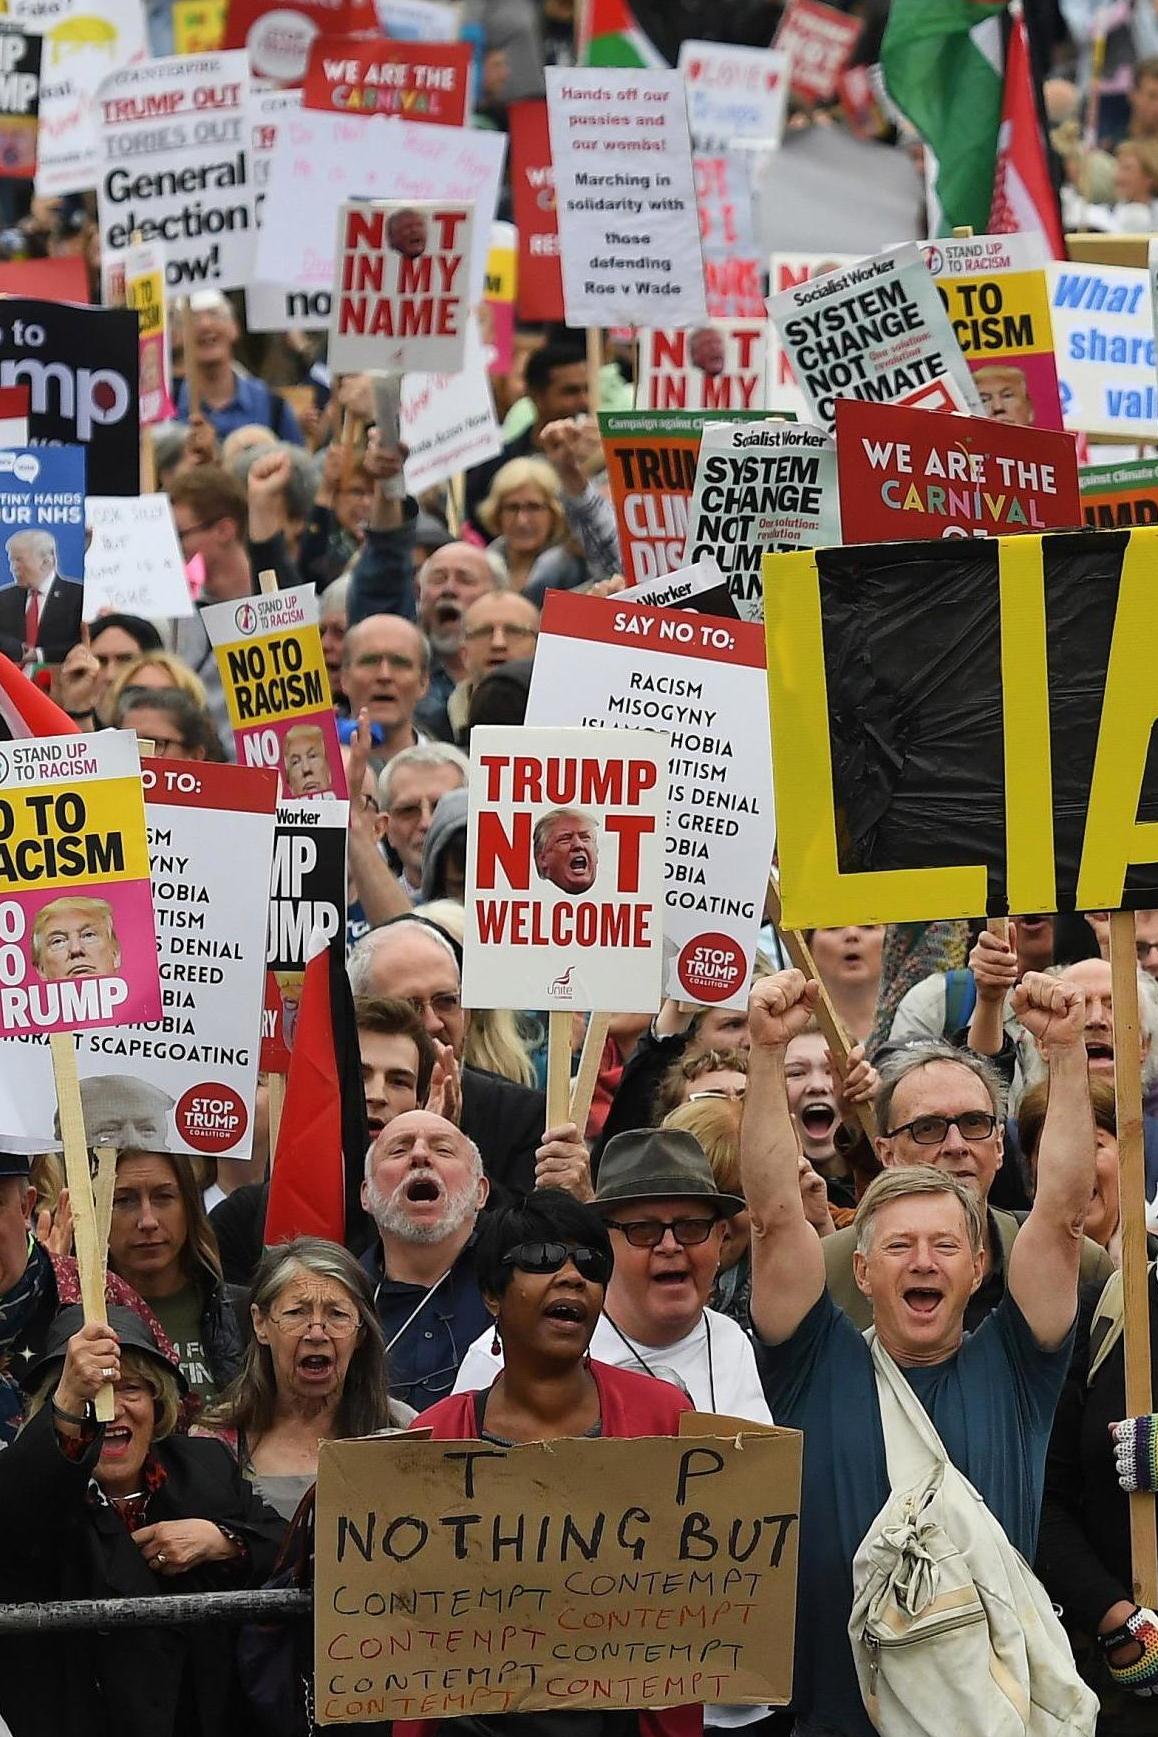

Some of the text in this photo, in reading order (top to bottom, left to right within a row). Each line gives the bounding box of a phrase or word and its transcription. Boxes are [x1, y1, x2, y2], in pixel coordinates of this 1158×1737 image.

[323, 59, 456, 91] WE ARE THE
[103, 90, 184, 121] TRUMP
[193, 83, 241, 107] OUT
[332, 85, 440, 115] CARNIVAL
[561, 87, 669, 102] Hands off our
[569, 114, 664, 127] pussies and
[572, 139, 597, 151] our
[106, 152, 247, 203] General
[575, 172, 650, 188] Marching
[656, 172, 670, 186] in
[567, 198, 684, 213] solidarity with
[107, 203, 249, 248] election
[604, 231, 651, 244] those
[589, 257, 671, 272] defending
[946, 246, 982, 259] STAND
[965, 256, 1011, 271] RACISM
[343, 256, 462, 293] IN MY
[584, 281, 682, 295] Roe Wade
[957, 282, 1003, 317] TO
[1053, 273, 1144, 314] What
[338, 299, 460, 336] NAME
[785, 280, 908, 347] SYSTEM
[14, 318, 45, 347] to
[796, 303, 925, 371] CHANGE
[804, 354, 867, 398] NOT
[651, 376, 758, 408] IN MY
[781, 431, 827, 448] Worker
[704, 456, 819, 485] SYSTEM
[862, 438, 913, 474] WE
[924, 448, 986, 483] ARE
[996, 458, 1058, 494] THE
[0, 492, 81, 505] TINY HANDS
[701, 486, 822, 514] CHANGE
[881, 479, 1045, 528] CARNIVAL
[38, 508, 82, 524] NHS
[696, 515, 755, 544] NOT
[257, 599, 283, 615] STAND
[270, 610, 304, 627] RACISM
[613, 612, 735, 650] SAY NO TO:
[228, 638, 303, 684] NO TO
[237, 671, 324, 720] RACISM
[630, 672, 703, 699] RACISM
[608, 695, 717, 727] MISOGYNY
[13, 743, 88, 764] STAND UP
[15, 760, 98, 781] TO RACISM
[480, 755, 657, 805] TRUMP
[25, 792, 86, 836] TO
[691, 788, 760, 815] DENIAL
[276, 808, 321, 826] Worker
[677, 812, 739, 837] GREED
[0, 832, 125, 882] ACISM
[476, 900, 653, 948] WELCOME
[171, 938, 243, 961] DENIAL
[694, 947, 735, 964] STOP
[159, 963, 224, 985] GREED
[686, 960, 738, 980] TRUMP
[689, 977, 729, 989] COALITION
[3, 976, 129, 1029] RUMP
[89, 1037, 250, 1067] SCAPEGOATING
[184, 1111, 239, 1128] TRUMP
[191, 1099, 234, 1115] STOP
[189, 1129, 231, 1139] COALITION
[337, 1506, 798, 1567] NOTHING BUT
[334, 1567, 762, 1617] CONTEMPT CONTEMPT
[328, 1603, 758, 1662] CONTEMPT CONTEMPT
[329, 1638, 743, 1695] CONTEMPT CONTEMPT
[325, 1674, 730, 1719] CONTEMPT CONTEMPT
